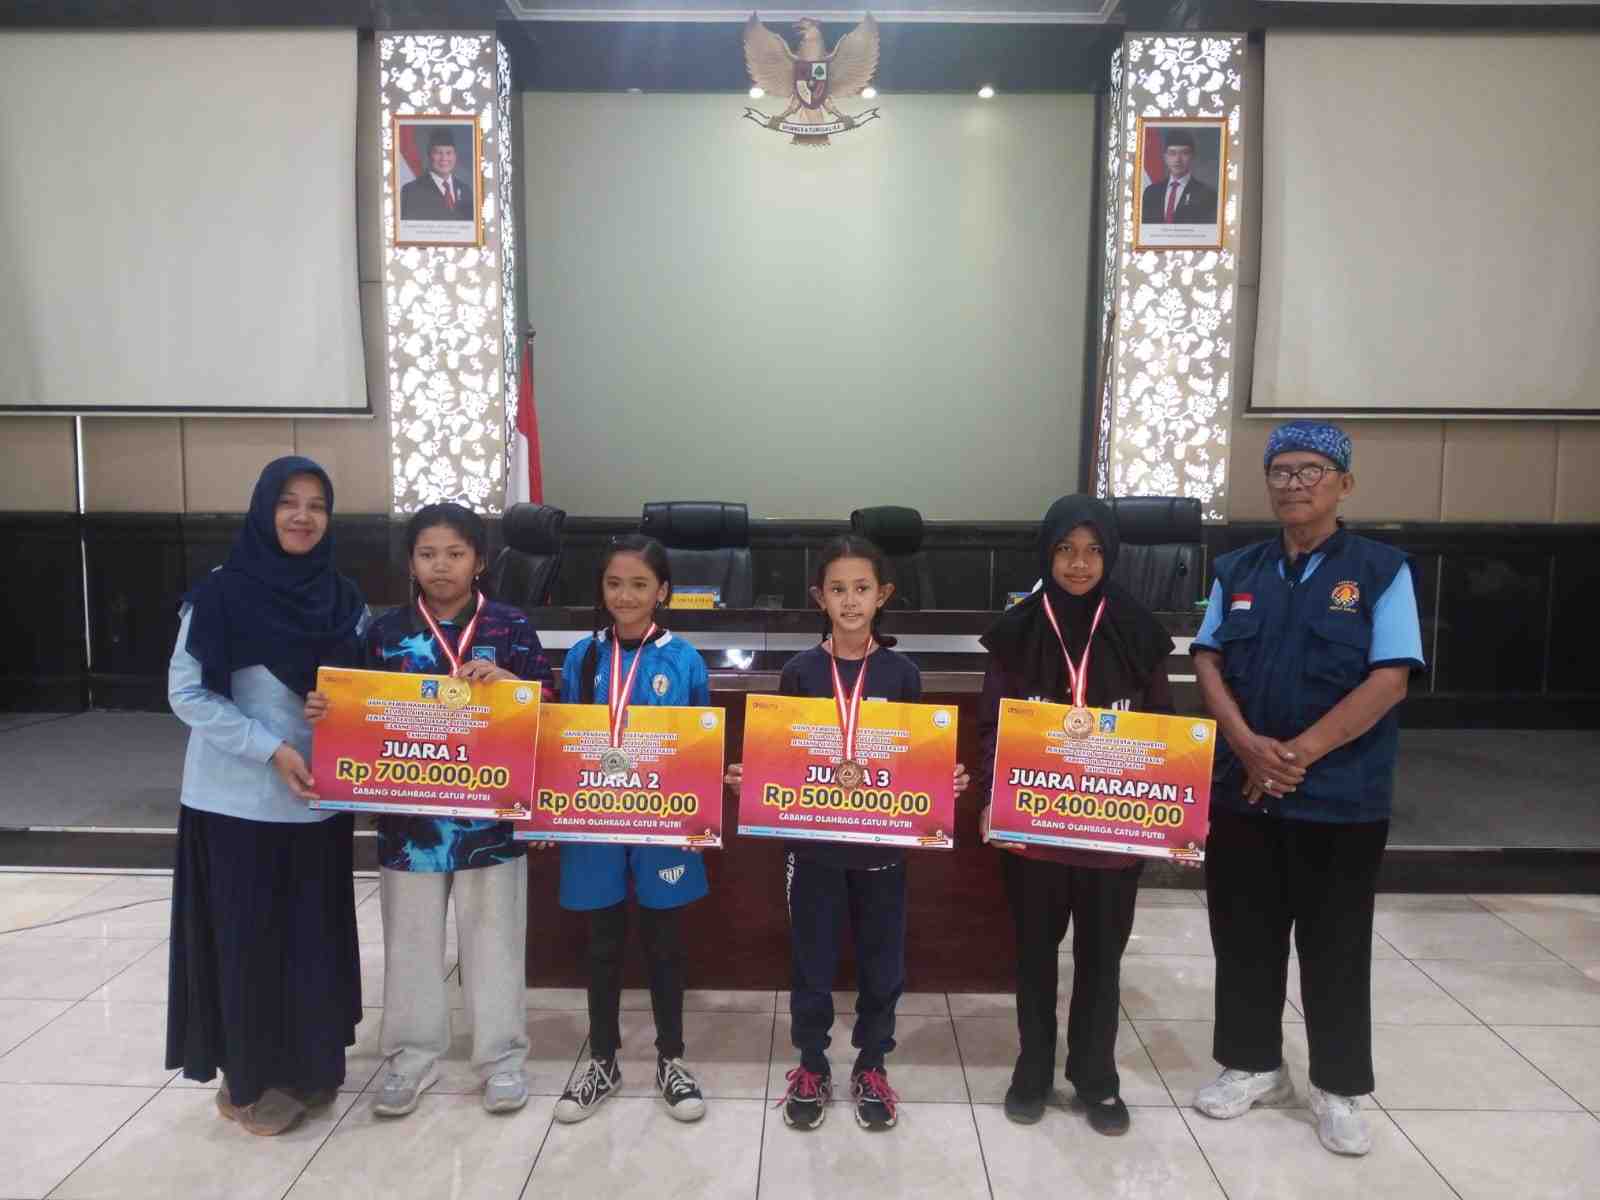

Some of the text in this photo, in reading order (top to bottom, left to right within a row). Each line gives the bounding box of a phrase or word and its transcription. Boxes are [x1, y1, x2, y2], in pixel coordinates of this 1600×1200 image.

[382, 741, 468, 762] JUARA 1
[337, 758, 508, 790] Rp 700.000,00
[578, 771, 660, 789] JUARA 2
[806, 766, 890, 787] JUA 3
[353, 786, 490, 801] CABANG OLAHRAGA CATUR PUTRI
[1009, 768, 1195, 803] JUARA HARAPAN 1
[538, 789, 698, 819] Rp 600.000,00
[764, 783, 929, 816] Rp 500.000,00
[1016, 789, 1184, 826] Rp 400.000,00
[553, 817, 586, 827] CABANG
[633, 819, 657, 829] CATUR
[659, 820, 682, 829] PUTRI
[779, 812, 912, 829] CABANG OLAHRAGA CATUR PUTRI
[1031, 818, 1165, 840] CABANG OLAHRAGA CATUR PUTRI
